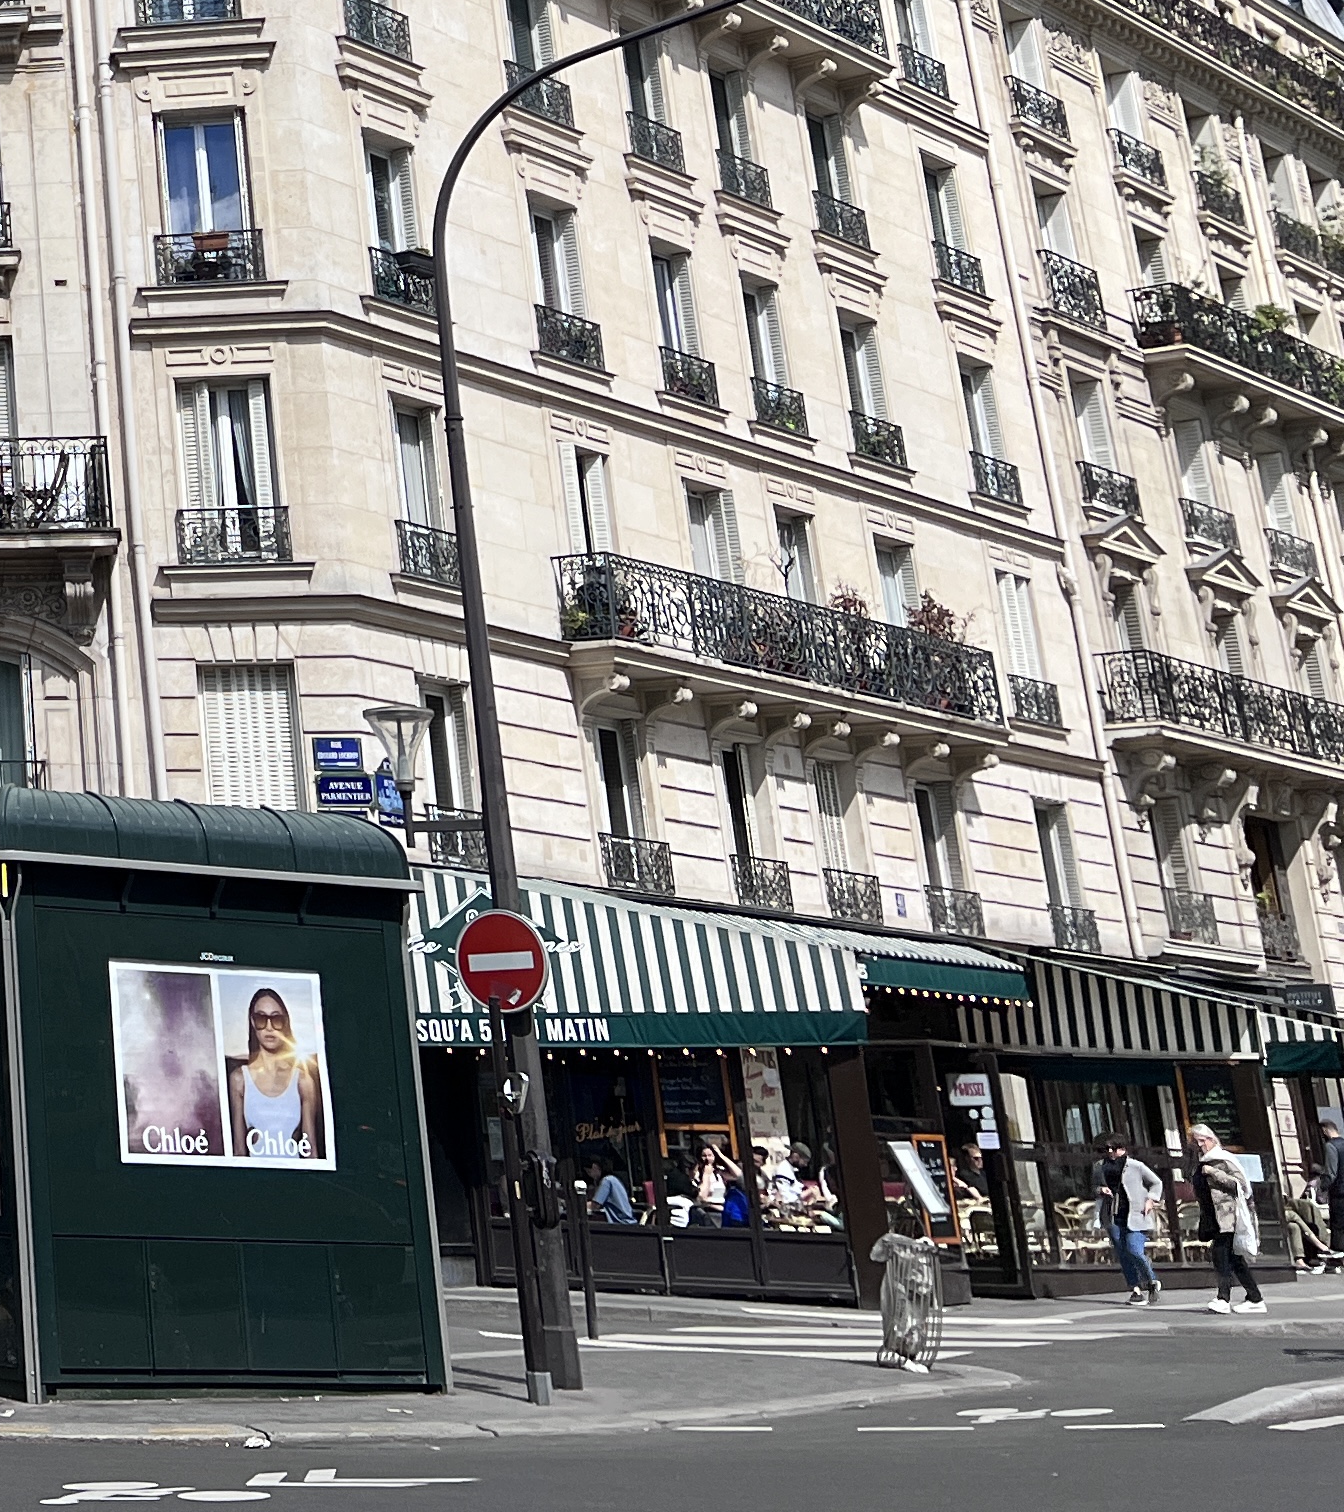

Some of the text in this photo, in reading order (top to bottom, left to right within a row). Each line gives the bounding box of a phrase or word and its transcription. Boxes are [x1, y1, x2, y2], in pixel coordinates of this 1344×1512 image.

[328, 781, 363, 790] AVENUE
[416, 1018, 474, 1042] SQU'A
[545, 1018, 611, 1042] MATIN
[142, 1125, 209, 1154] Chloé
[246, 1129, 312, 1158] Chloé
